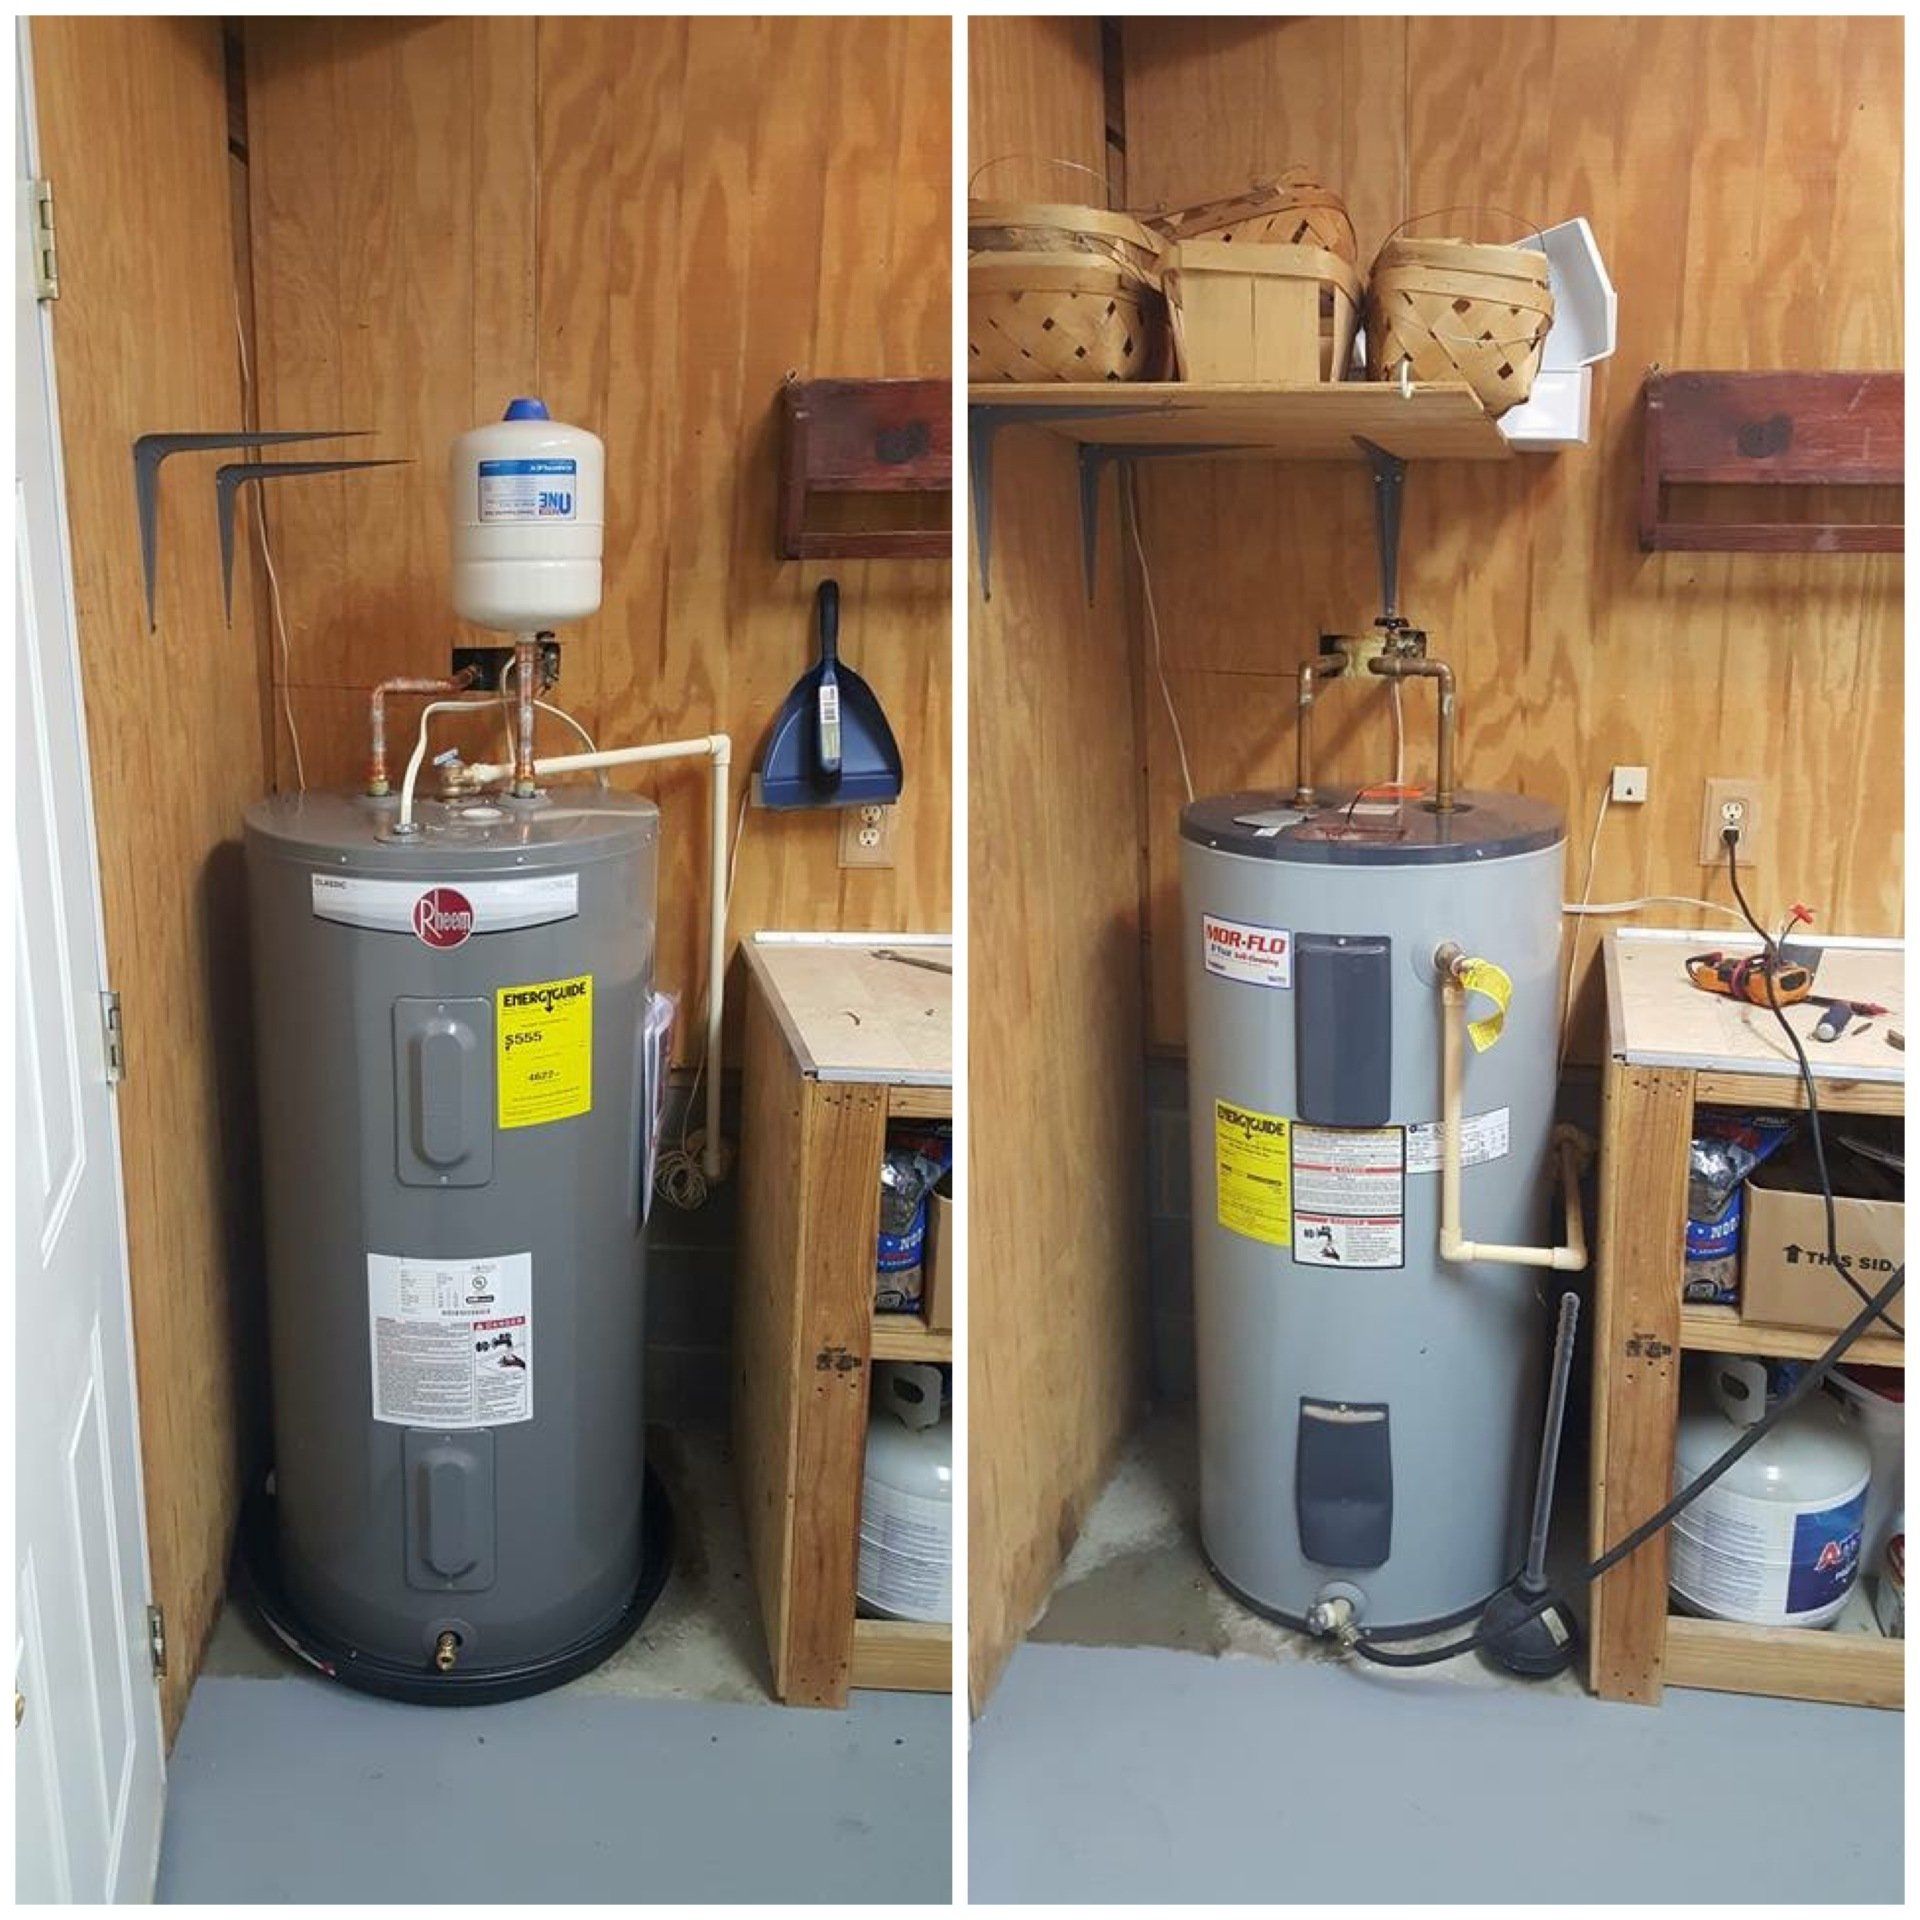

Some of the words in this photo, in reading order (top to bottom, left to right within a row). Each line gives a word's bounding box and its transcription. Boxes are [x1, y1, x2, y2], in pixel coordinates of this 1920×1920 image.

[420, 889, 471, 939] Rheem
[1807, 1251, 1853, 1268] THS
[1858, 1256, 1896, 1273] SID
